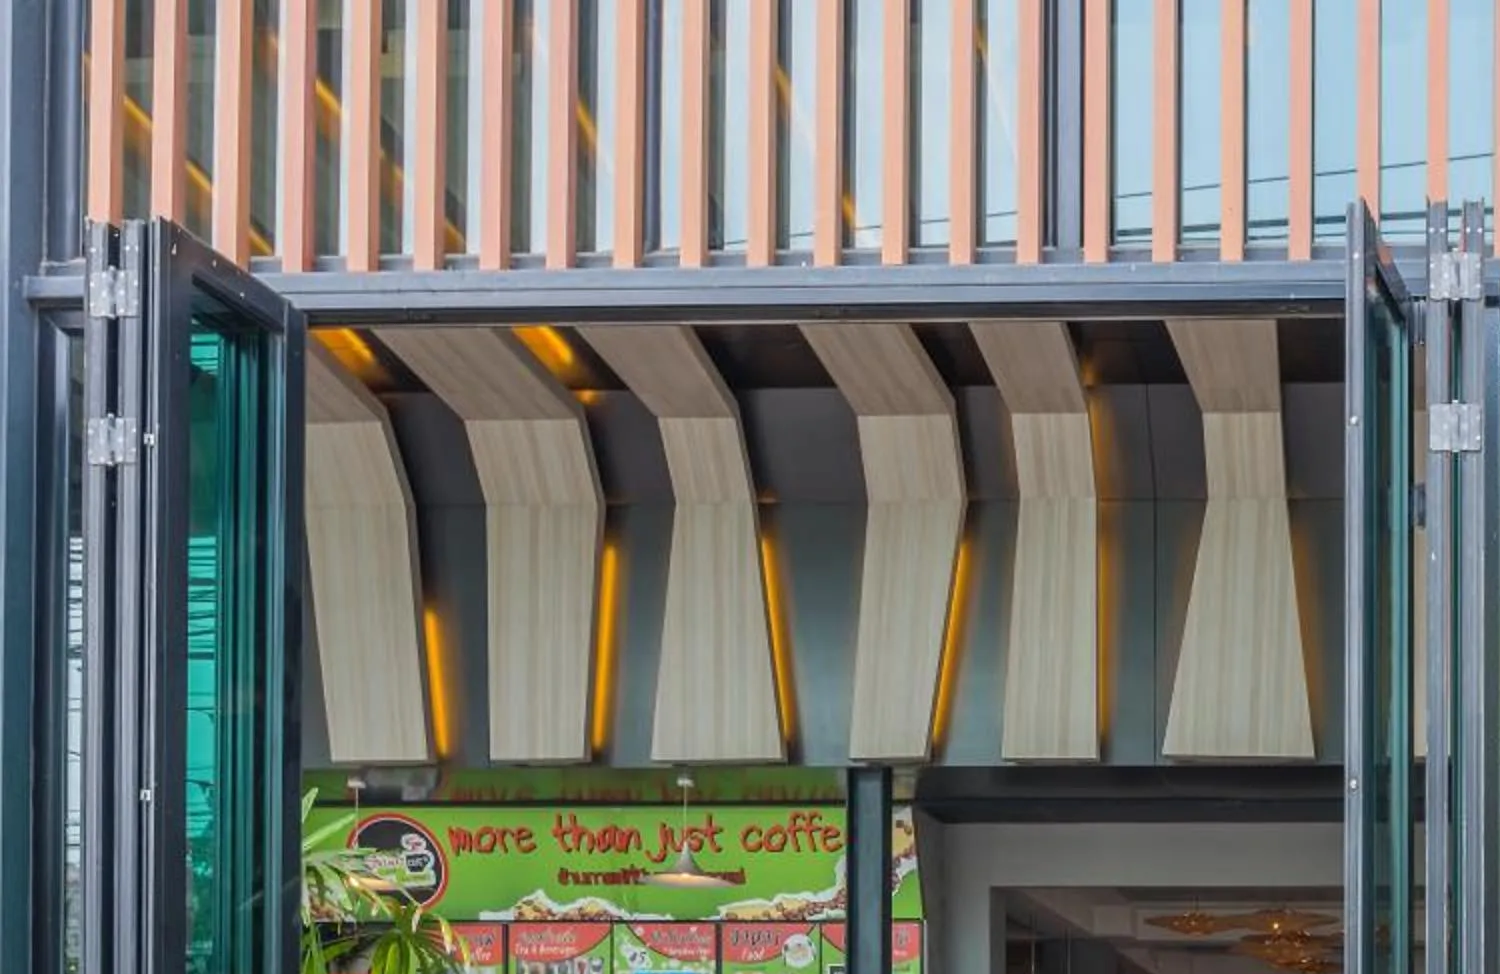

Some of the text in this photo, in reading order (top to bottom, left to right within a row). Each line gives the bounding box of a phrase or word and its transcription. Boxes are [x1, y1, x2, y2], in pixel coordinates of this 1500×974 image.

[447, 811, 843, 863] more than just coffe
